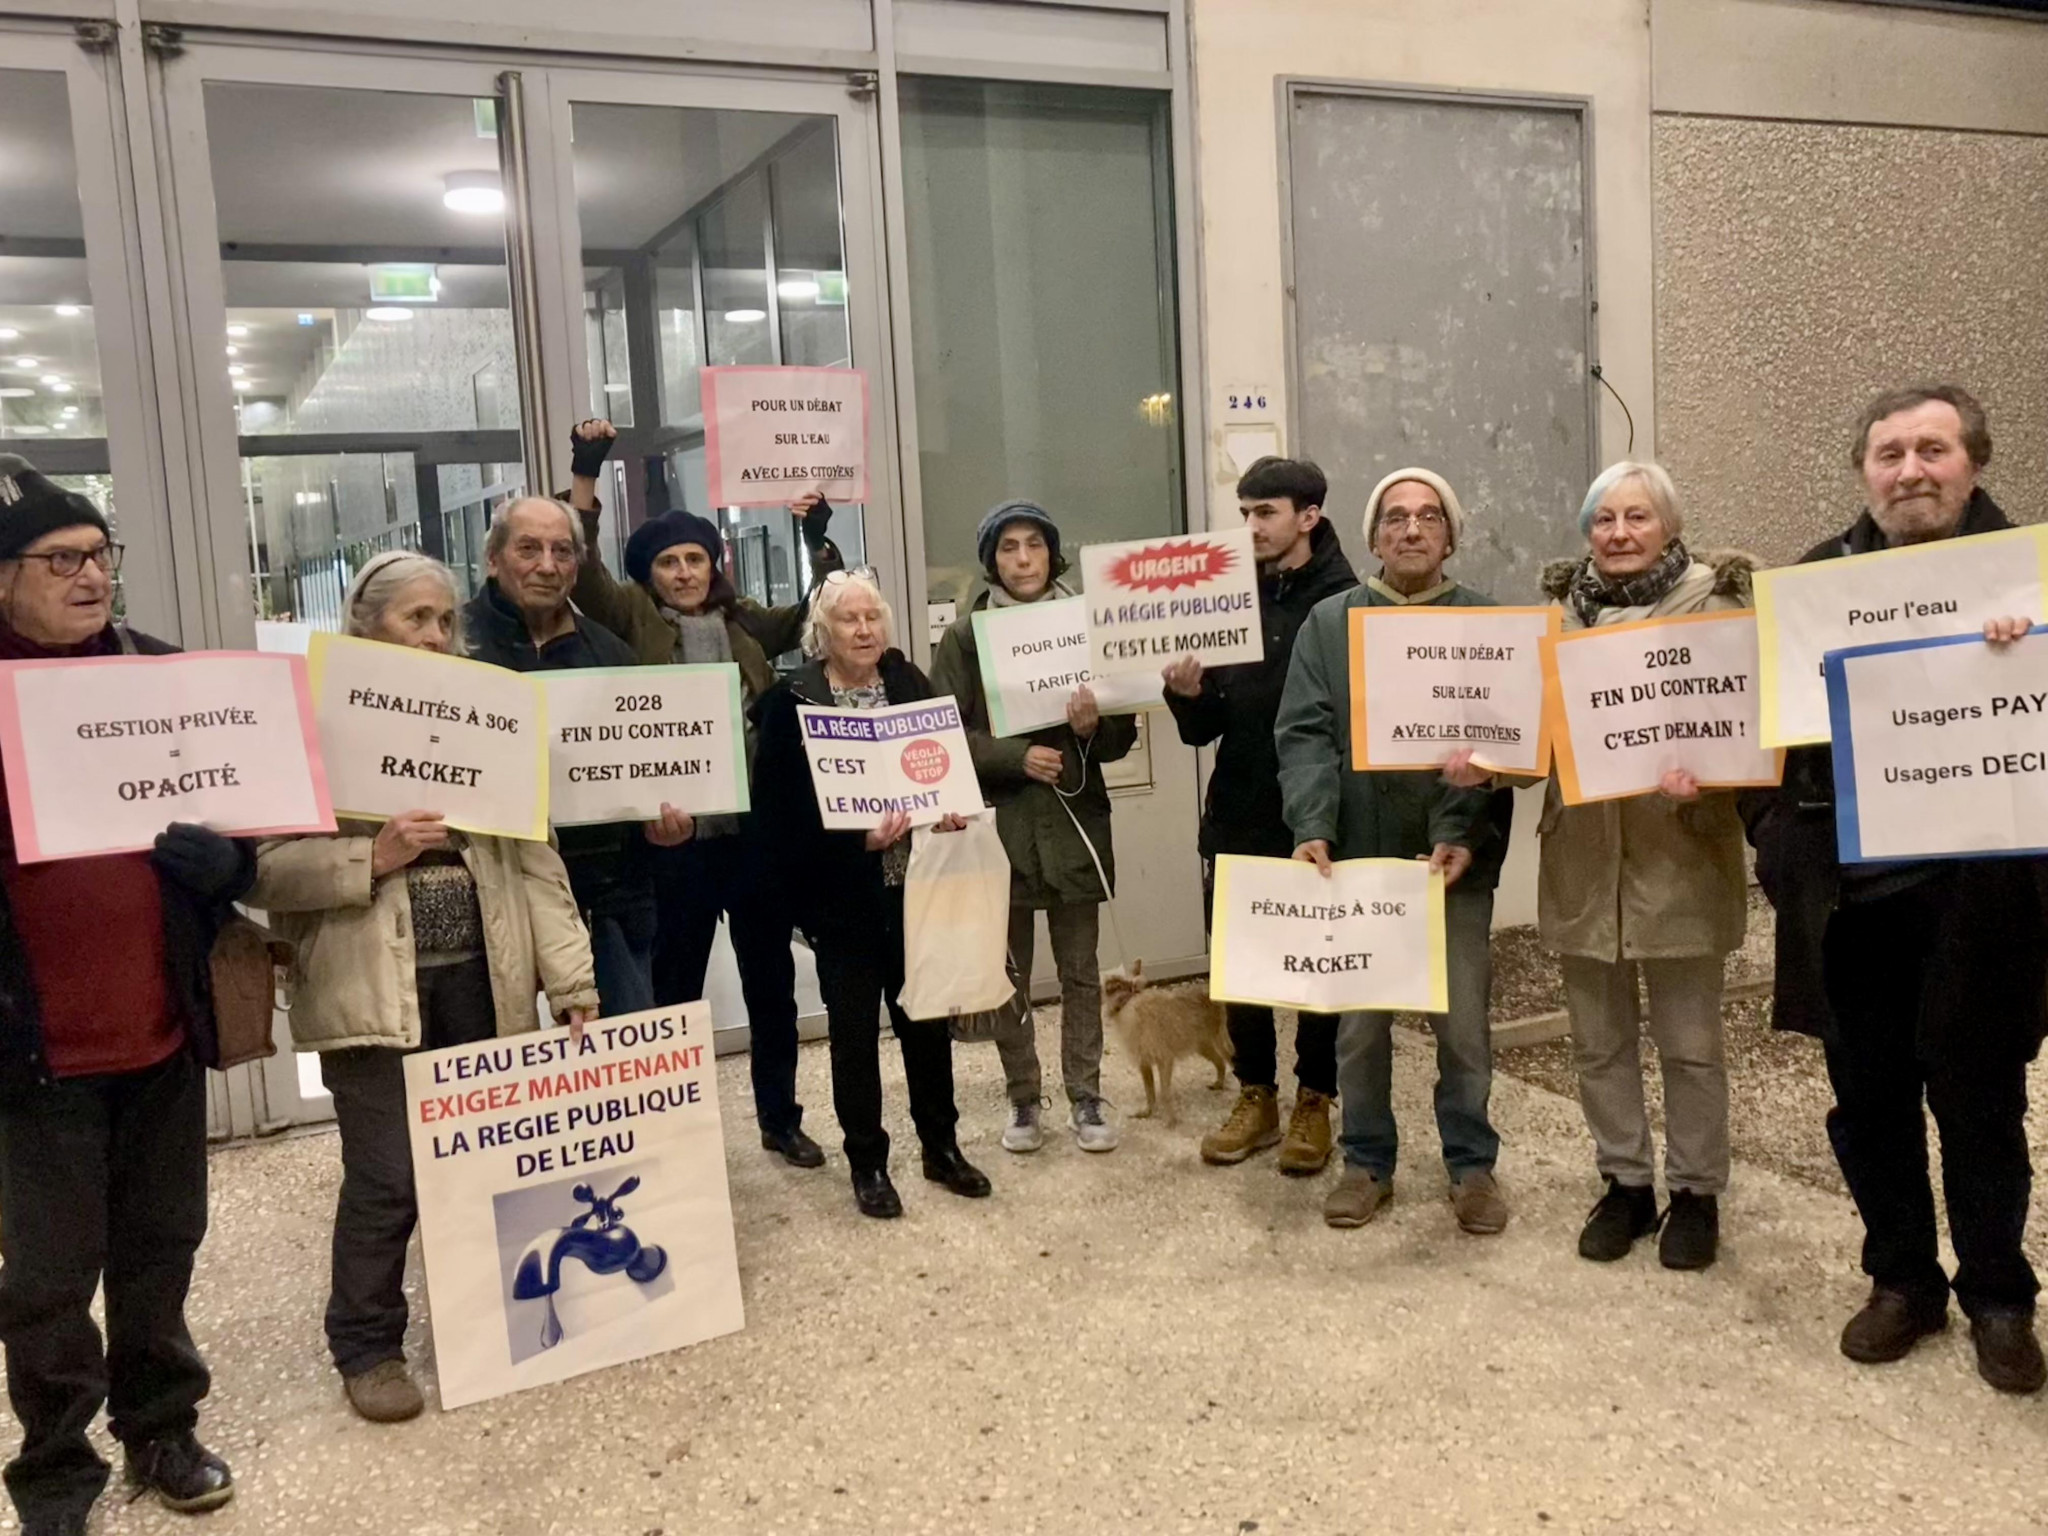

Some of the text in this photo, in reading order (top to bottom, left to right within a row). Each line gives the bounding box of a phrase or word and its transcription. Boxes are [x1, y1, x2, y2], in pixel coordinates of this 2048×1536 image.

[752, 397, 842, 411] POUR UN DÉBAT
[1229, 395, 1266, 408] 246
[774, 433, 830, 445] SUR L'EAU
[741, 464, 854, 479] AVEC LES CITOYENS
[1129, 552, 1210, 580] URGENT
[1094, 592, 1253, 626] LA RÉGIE PUBLIQUE
[1848, 599, 1958, 625] Pour l'eau
[1012, 632, 1087, 657] POUR UNE
[1102, 627, 1250, 660] C'EST LE MOMENT
[1407, 643, 1515, 660] POUR UN DÉBAT
[1644, 647, 1691, 668] 2028
[1026, 669, 1103, 692] TARIFIC
[1432, 685, 1490, 699] SUR L'EAU
[1590, 674, 1747, 708] FIN DU CONTRAT
[349, 688, 519, 733] PÉNALITÉS À 30€
[615, 694, 662, 712] 2028
[1892, 692, 2047, 726] Usagers PAY
[76, 706, 258, 739] GESTION PRIVÉE
[561, 720, 714, 742] FIN DU CONTRAT
[807, 708, 959, 738] LA RÉGIE PUBLIQUE
[1391, 723, 1521, 741] AVEC LES CITOYENS
[1604, 720, 1745, 749] C'EST DEMAIN !
[380, 755, 482, 787] RACKET
[568, 759, 712, 782] C'EST DEMAIN !
[817, 757, 866, 774] C'EST
[915, 766, 944, 780] STOP
[1884, 751, 2046, 783] Usagers DECI
[118, 763, 241, 800] OPACITÉ
[826, 790, 941, 813] LE MOMENT
[1251, 898, 1406, 920] PÉNALITÉS À 30€
[1283, 952, 1373, 974] RACKET
[433, 1014, 689, 1083] L'EAU EST A TOUS !
[420, 1045, 704, 1123] EXIGEZ MAINTENANT
[433, 1081, 701, 1158] LA REGIE PUBLIQUE
[516, 1130, 635, 1177] DE L'EAU
